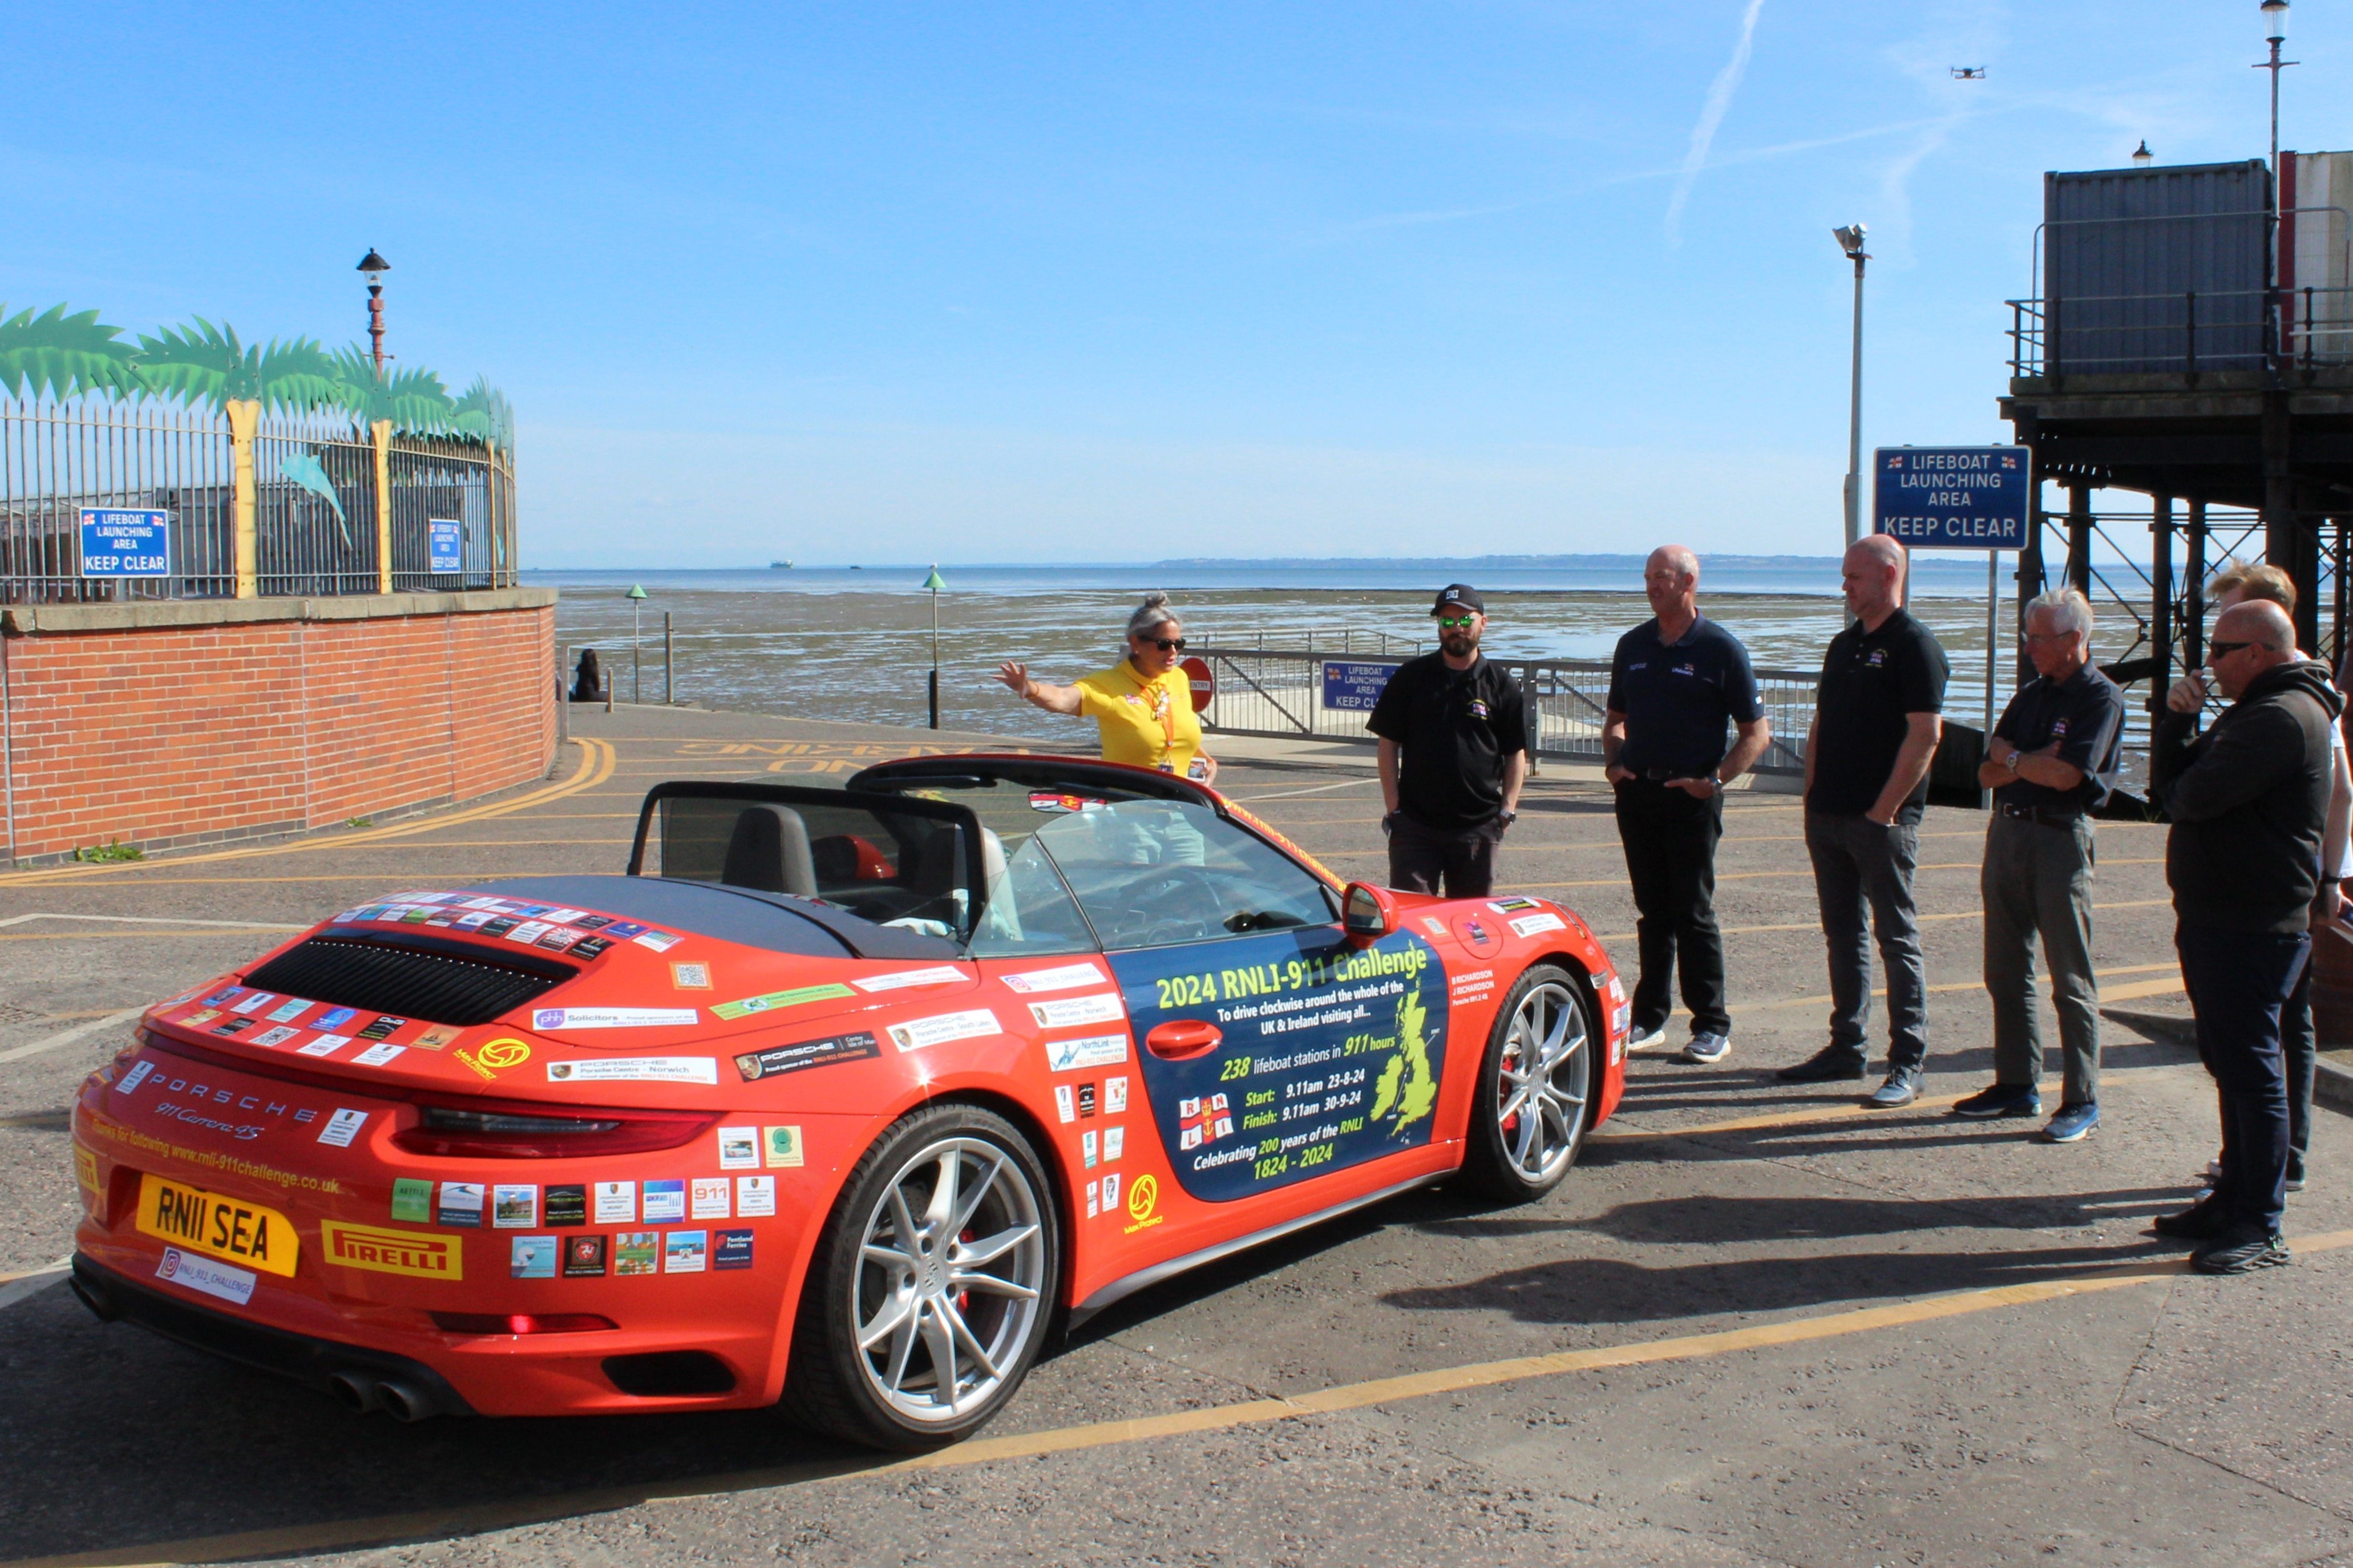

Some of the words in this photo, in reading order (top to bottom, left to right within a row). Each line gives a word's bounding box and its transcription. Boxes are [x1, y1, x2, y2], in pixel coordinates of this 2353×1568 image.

[1913, 455, 1991, 469] LIFEBOAT
[1901, 473, 2001, 488] LAUNCHING
[1928, 492, 1971, 506] AREA
[102, 514, 145, 525] LIFEBOAT
[1884, 517, 1938, 536] KEEP
[1946, 517, 2016, 537] CLEAR
[97, 526, 153, 537] LAUNCHING
[113, 539, 138, 549] AREA
[86, 556, 119, 570] KEEP
[124, 556, 165, 570] CLEAR
[1348, 666, 1383, 675] LIFEBOAT
[1345, 676, 1388, 685] LAUNCHING
[1336, 696, 1361, 707] KEEP
[1157, 973, 1217, 1009] 2024
[1222, 956, 1327, 1000] RNLI-911
[1333, 948, 1427, 983] Challenge
[1452, 977, 1456, 986] B
[1456, 969, 1494, 984] RICHARDSON
[1452, 987, 1457, 996] J
[1456, 980, 1495, 996] RICHARDSON
[1045, 999, 1093, 1010] PORSCHE
[1218, 1007, 1231, 1022] To
[1233, 1005, 1258, 1020] drive
[1260, 995, 1303, 1016] clockwise
[1304, 991, 1337, 1010] around
[1338, 989, 1352, 1003] the
[1353, 984, 1380, 1001] whole
[1380, 983, 1389, 996] of
[1389, 981, 1404, 995] the
[540, 1012, 563, 1026] phh
[911, 1015, 967, 1029] PORSCHE
[1261, 1021, 1276, 1035] UK
[1277, 1019, 1286, 1033] &
[1287, 1014, 1319, 1031] Ireland
[1321, 1009, 1352, 1028] visiting
[1353, 1004, 1371, 1021] all...
[1081, 1038, 1109, 1050] NorthLink
[760, 1042, 835, 1063] PORSCHE
[1096, 1054, 1125, 1063] CHALLENGE
[1220, 1056, 1251, 1081] 238
[1253, 1056, 1292, 1075] lifeboat
[1293, 1050, 1330, 1069] stations
[1332, 1044, 1341, 1059] in
[1344, 1034, 1369, 1057] 911
[1370, 1035, 1396, 1052] hours
[456, 1048, 474, 1063] Max
[471, 1060, 497, 1079] Protect
[1246, 1089, 1275, 1107] Start:
[1285, 1080, 1323, 1099] 9.11am
[1327, 1068, 1365, 1089] 23-8-24
[149, 1074, 317, 1123] PORSCHE
[1186, 1104, 1195, 1113] R
[1215, 1095, 1224, 1106] N
[1243, 1109, 1278, 1130] Finish:
[1282, 1101, 1320, 1122] 9.11am
[1324, 1089, 1362, 1112] 30-9-24
[155, 1103, 176, 1117] 911
[177, 1108, 233, 1132] Carrera
[235, 1125, 265, 1140] 4S
[129, 1130, 169, 1158] following
[1188, 1133, 1195, 1146] L
[1194, 1144, 1257, 1171] Celebrating
[1259, 1137, 1279, 1156] 200
[1280, 1131, 1307, 1153] years
[1309, 1127, 1321, 1143] of
[1322, 1124, 1338, 1138] the
[1340, 1116, 1364, 1135] RNLI
[1254, 1154, 1288, 1180] 1824
[1299, 1142, 1334, 1169] 2024
[399, 1188, 425, 1196] KETTLE
[694, 1187, 727, 1200] 911
[212, 1204, 268, 1261] SEA
[1124, 1223, 1139, 1234] Max
[1139, 1215, 1163, 1229] Protect
[332, 1229, 448, 1271] PIRELLI
